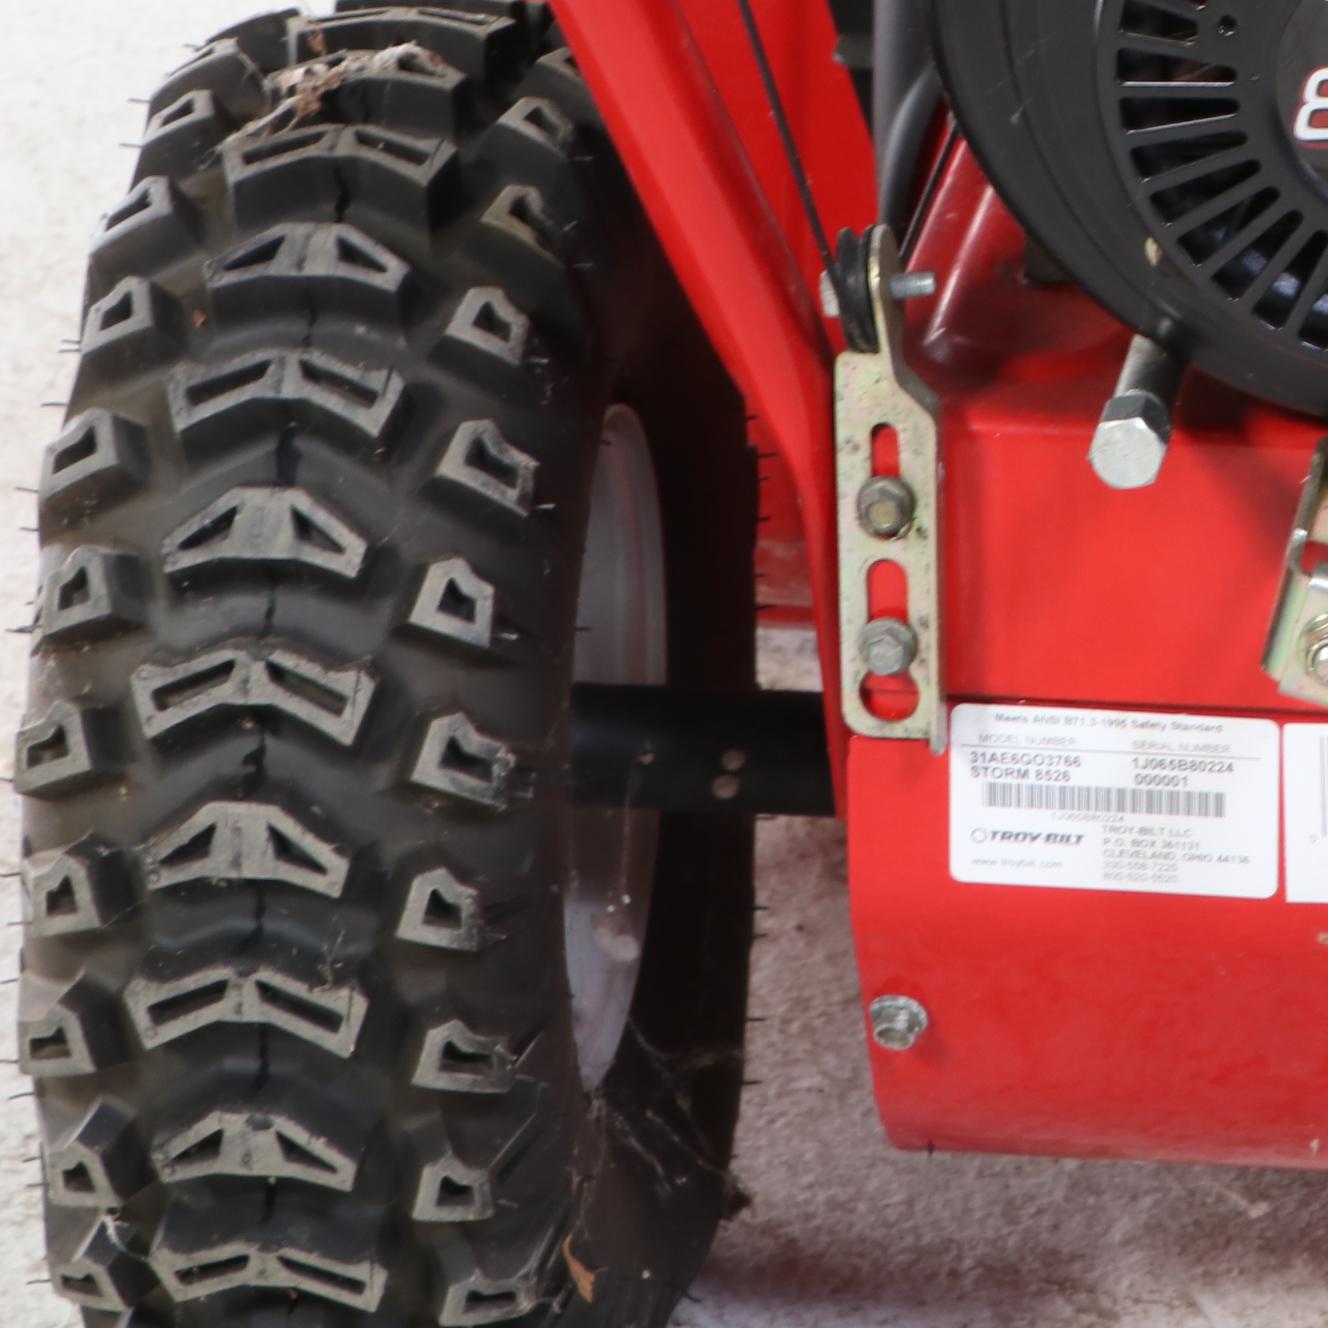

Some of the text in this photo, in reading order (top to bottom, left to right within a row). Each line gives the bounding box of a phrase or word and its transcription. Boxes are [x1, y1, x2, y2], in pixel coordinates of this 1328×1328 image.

[1032, 714, 1060, 725] ANSI
[1131, 719, 1167, 732] Safety
[1171, 721, 1224, 732] Standard
[979, 734, 1077, 747] MODEL NUMBER
[1132, 740, 1231, 753] SERIAL NUMBER
[970, 765, 1030, 779] STORM
[1134, 773, 1189, 787] 000001
[1168, 828, 1192, 838] LLC
[1130, 838, 1156, 848] BOX
